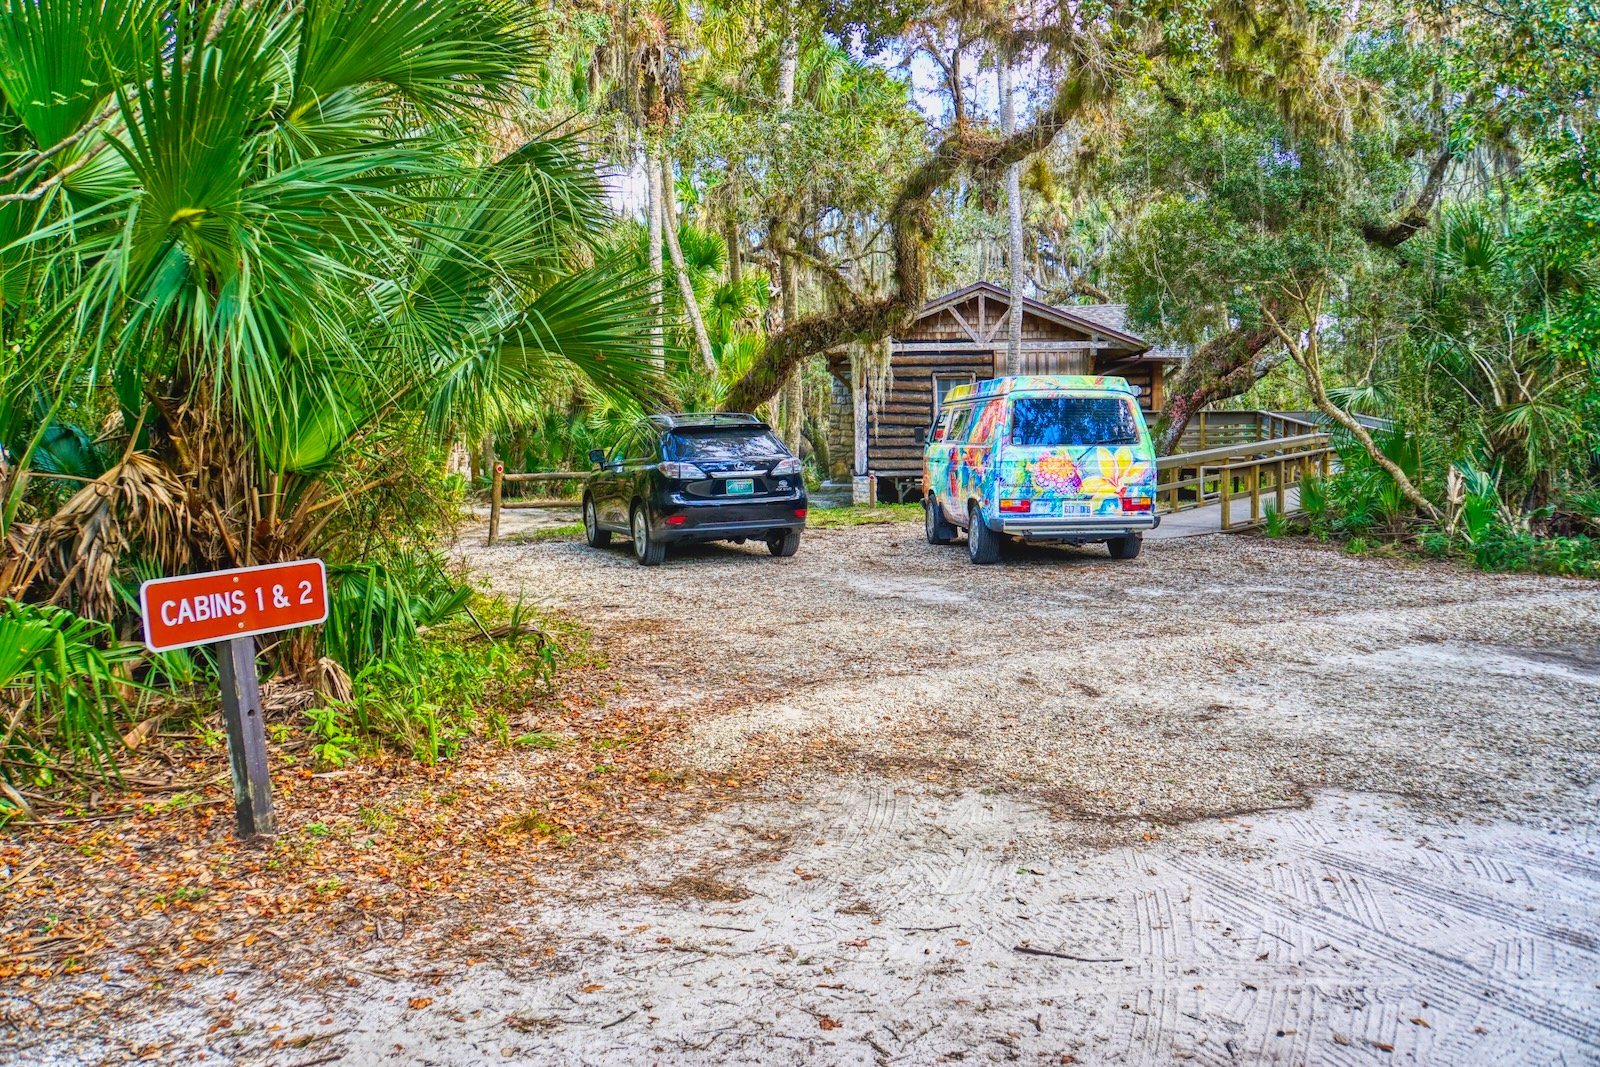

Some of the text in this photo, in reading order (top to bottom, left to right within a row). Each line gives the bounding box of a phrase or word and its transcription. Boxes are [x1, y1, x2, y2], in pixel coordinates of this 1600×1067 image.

[160, 580, 313, 626] CABINS 1 & 2
